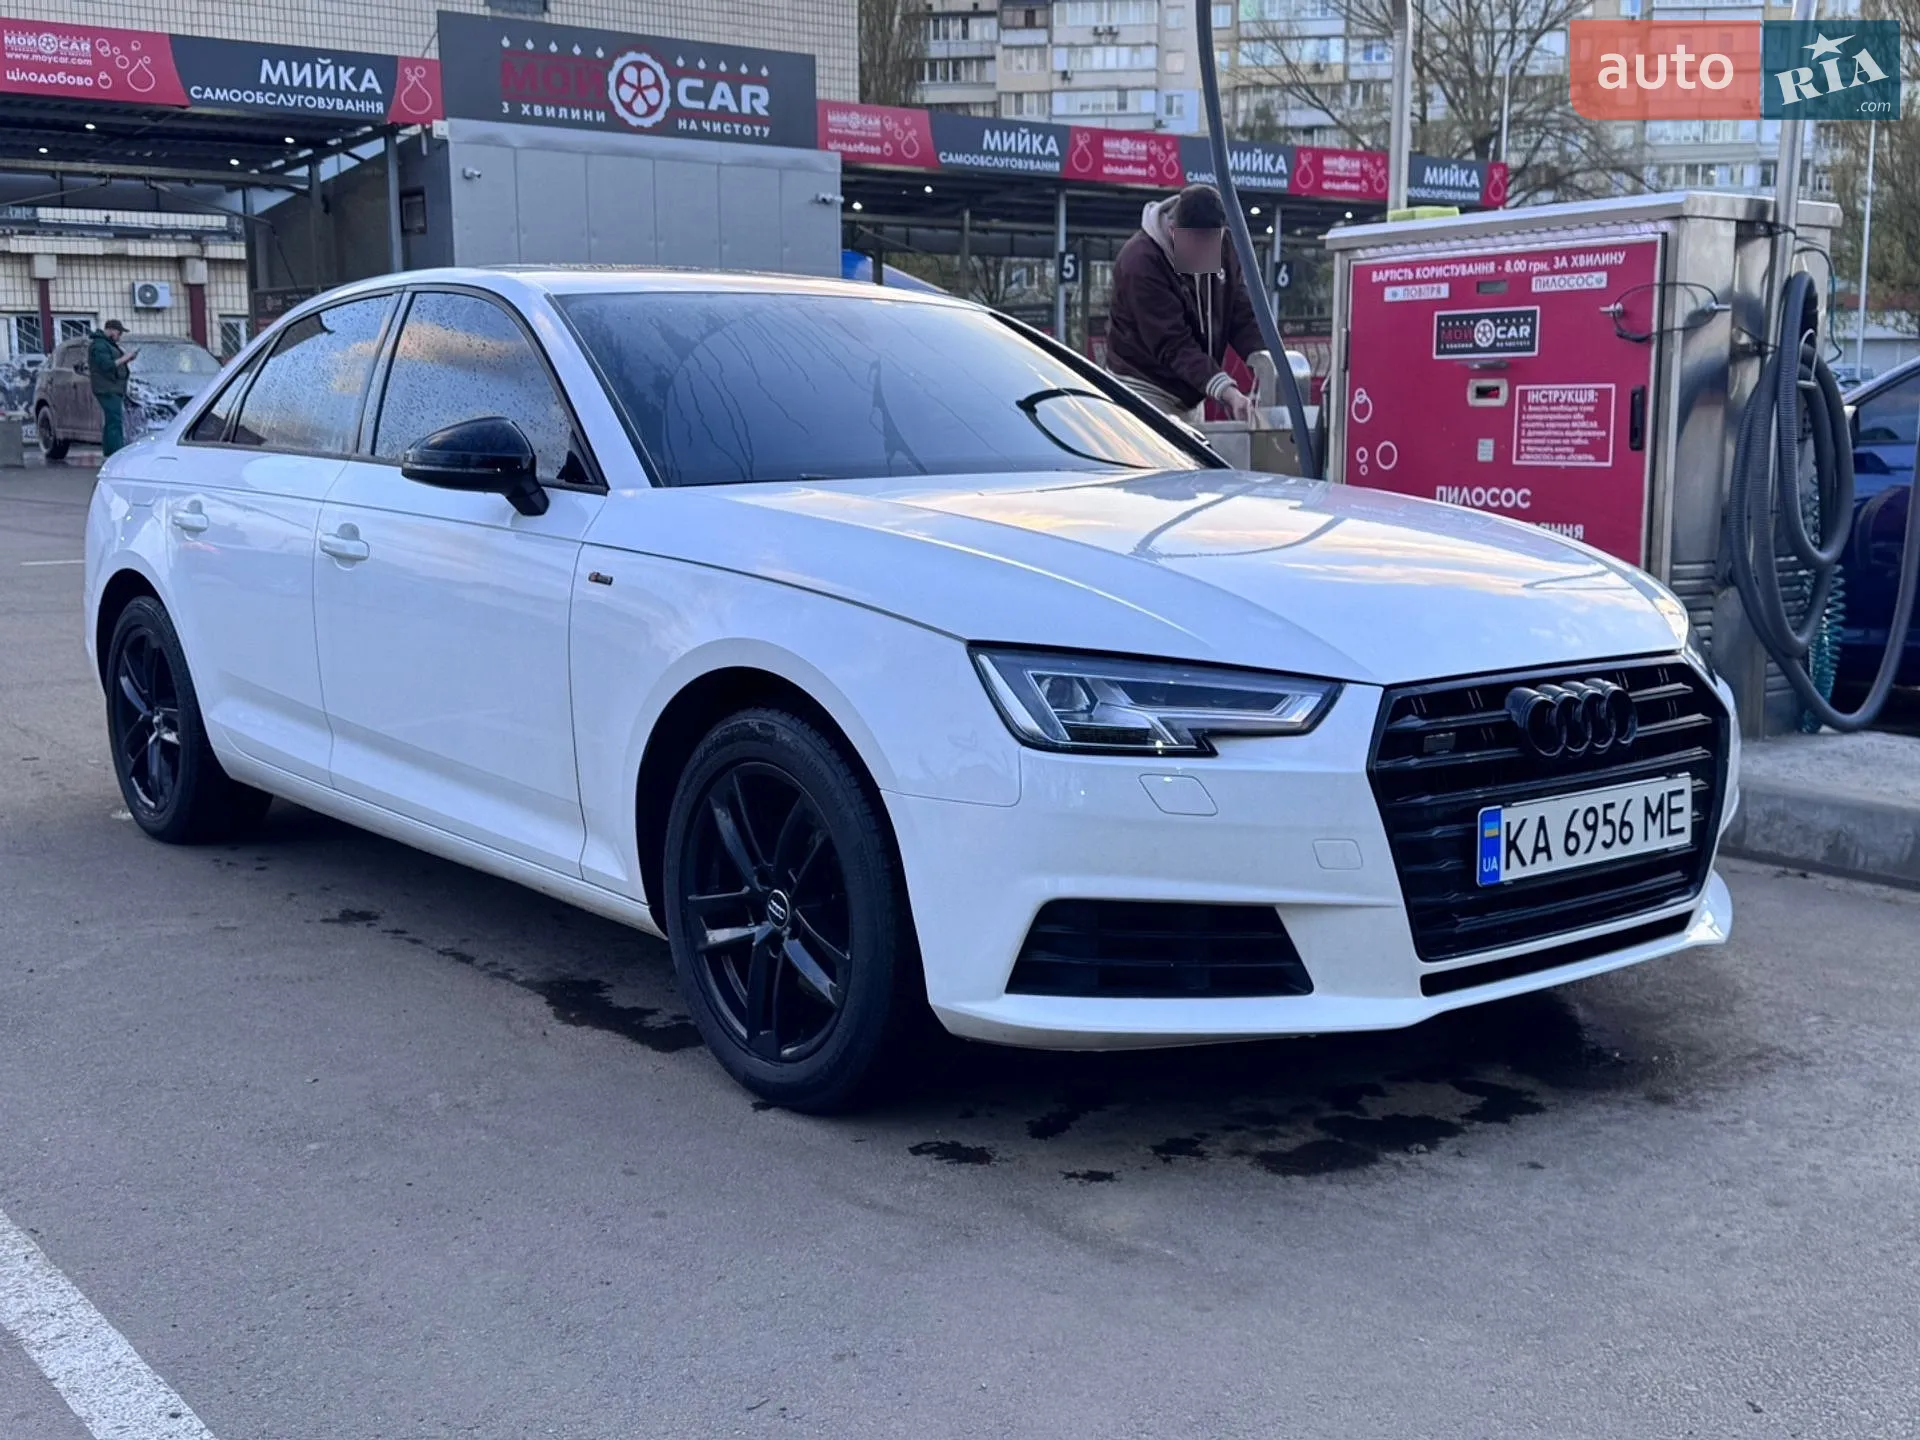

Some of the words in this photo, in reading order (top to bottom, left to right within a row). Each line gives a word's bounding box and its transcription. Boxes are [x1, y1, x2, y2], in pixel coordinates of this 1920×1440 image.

[60, 41, 91, 52] CAR
[259, 57, 383, 95] МИЙКА
[190, 86, 384, 114] САМООБСЛУГОВУВАННЯ
[677, 78, 771, 116] CAR
[521, 103, 606, 123] ХВИЛИНИ
[678, 118, 698, 131] НА
[703, 120, 771, 138] ЧИСТОТУ
[982, 127, 1060, 157] МИЙКА
[1228, 148, 1288, 175] МИЙКА
[1423, 164, 1480, 188] МИЙКА
[1062, 254, 1076, 279] 5
[1277, 263, 1289, 287] 6
[1415, 261, 1495, 279] КОРИСТУВАННЯ
[1553, 255, 1569, 269] ЗА
[1570, 251, 1626, 268] ХВИЛИНУ
[1534, 275, 1595, 289] ПИЛОСОС
[1496, 325, 1531, 339] CAR
[1435, 485, 1532, 508] ПИЛОСОС
[1505, 815, 1552, 871] KA
[1564, 798, 1634, 857] 6956
[1644, 789, 1685, 842] ME
[1482, 857, 1498, 873] UA
